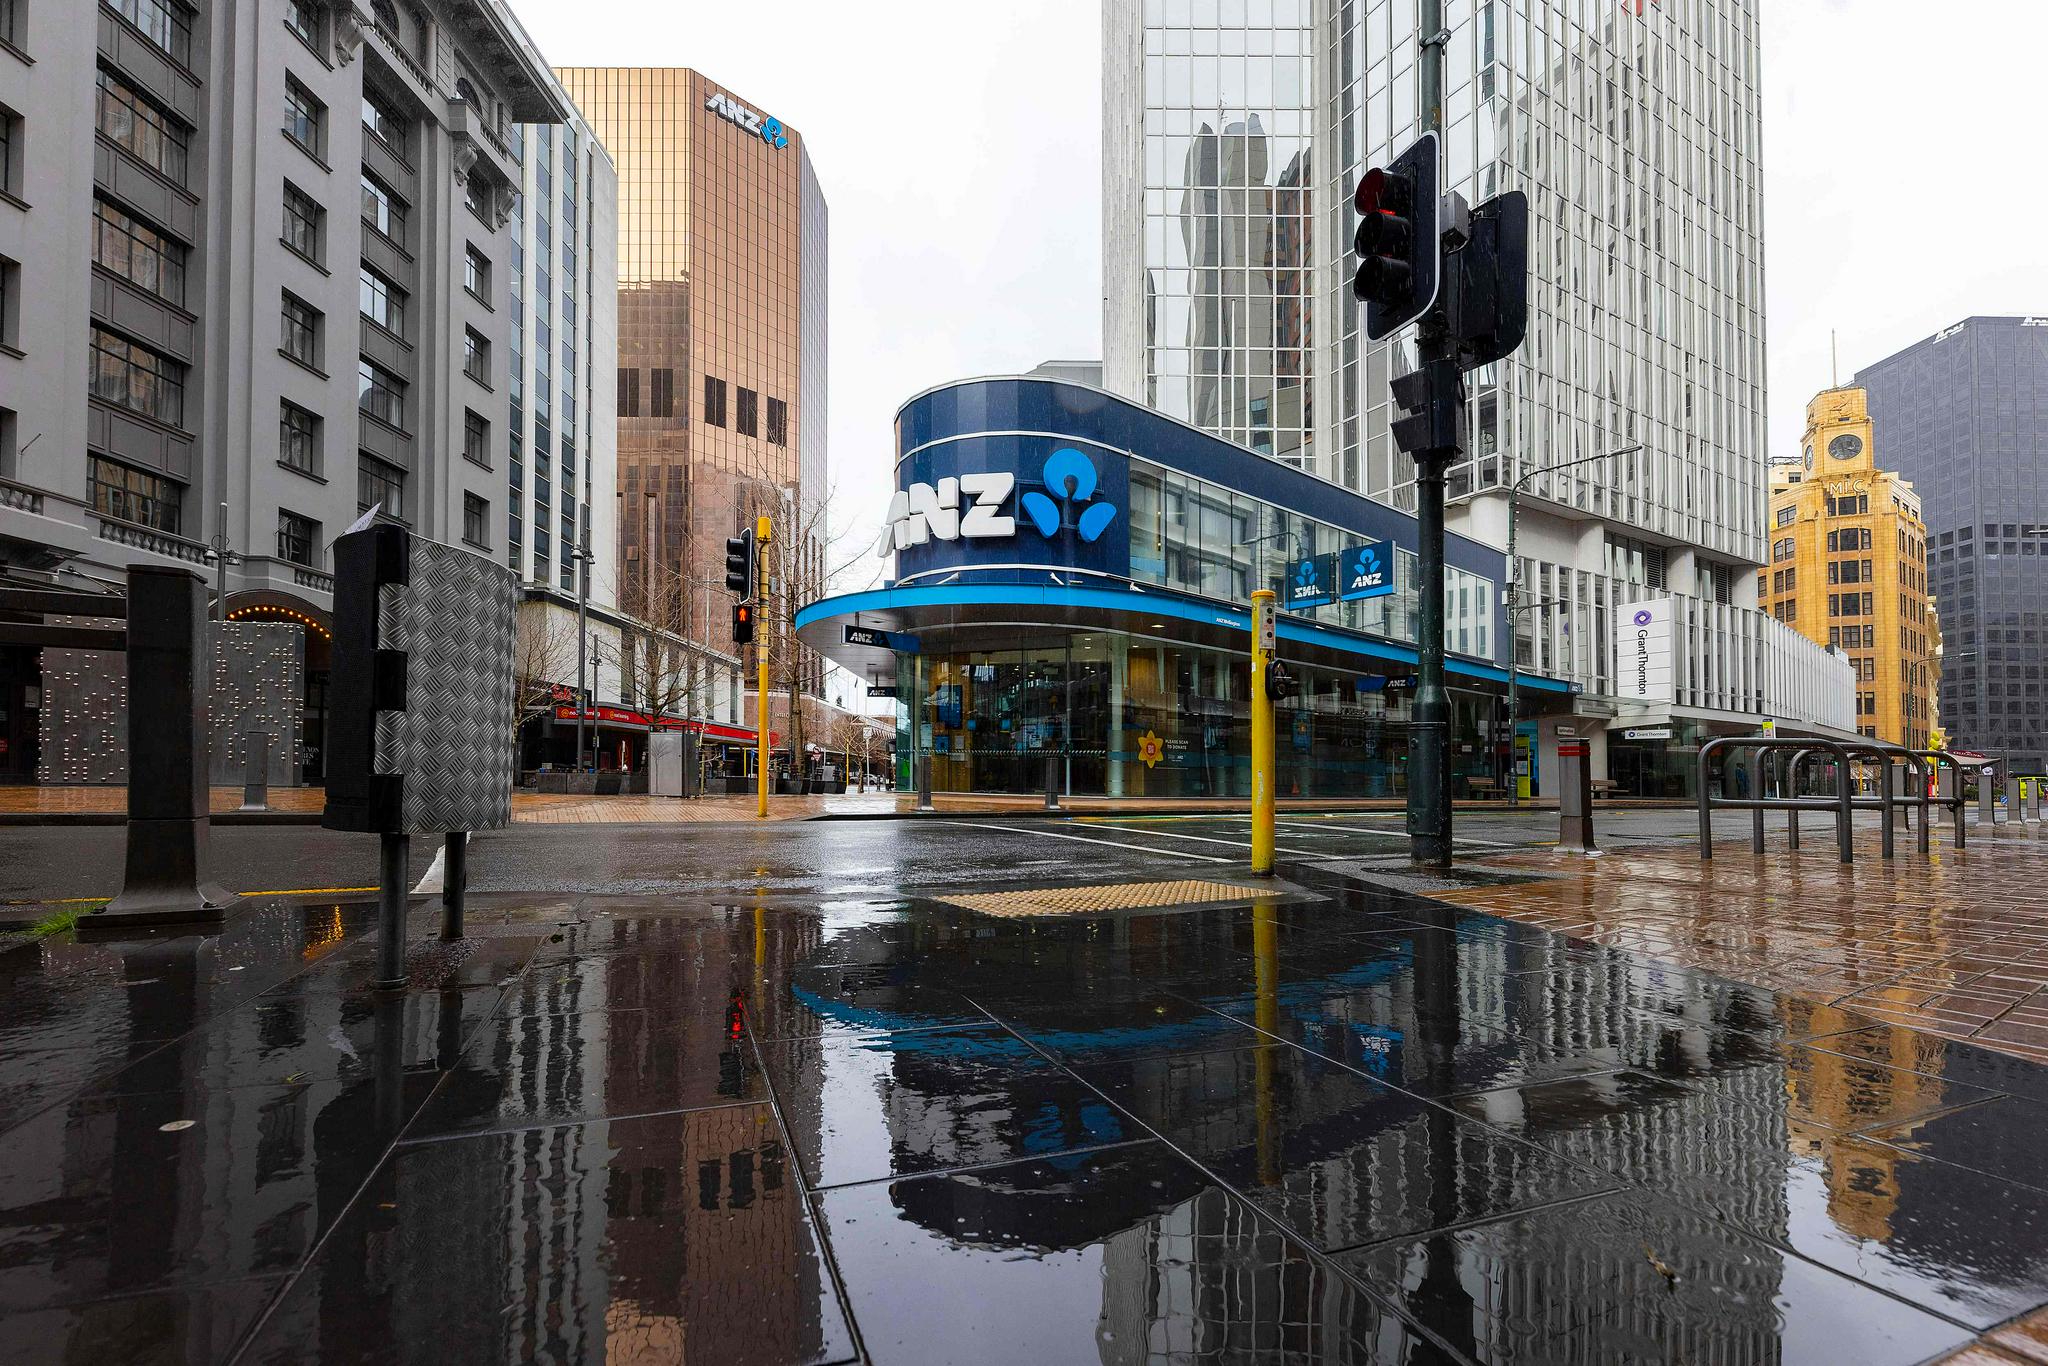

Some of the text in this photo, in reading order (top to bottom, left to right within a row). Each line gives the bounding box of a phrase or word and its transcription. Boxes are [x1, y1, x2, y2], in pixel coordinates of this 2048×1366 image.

[705, 93, 761, 136] ANZ
[1829, 479, 1866, 495] MLC
[877, 472, 1016, 558] ANZ
[1351, 572, 1382, 589] ANZ
[850, 631, 873, 643] ANZ
[1637, 629, 1649, 695] Grant Thornton
[1387, 679, 1406, 688] ANZ
